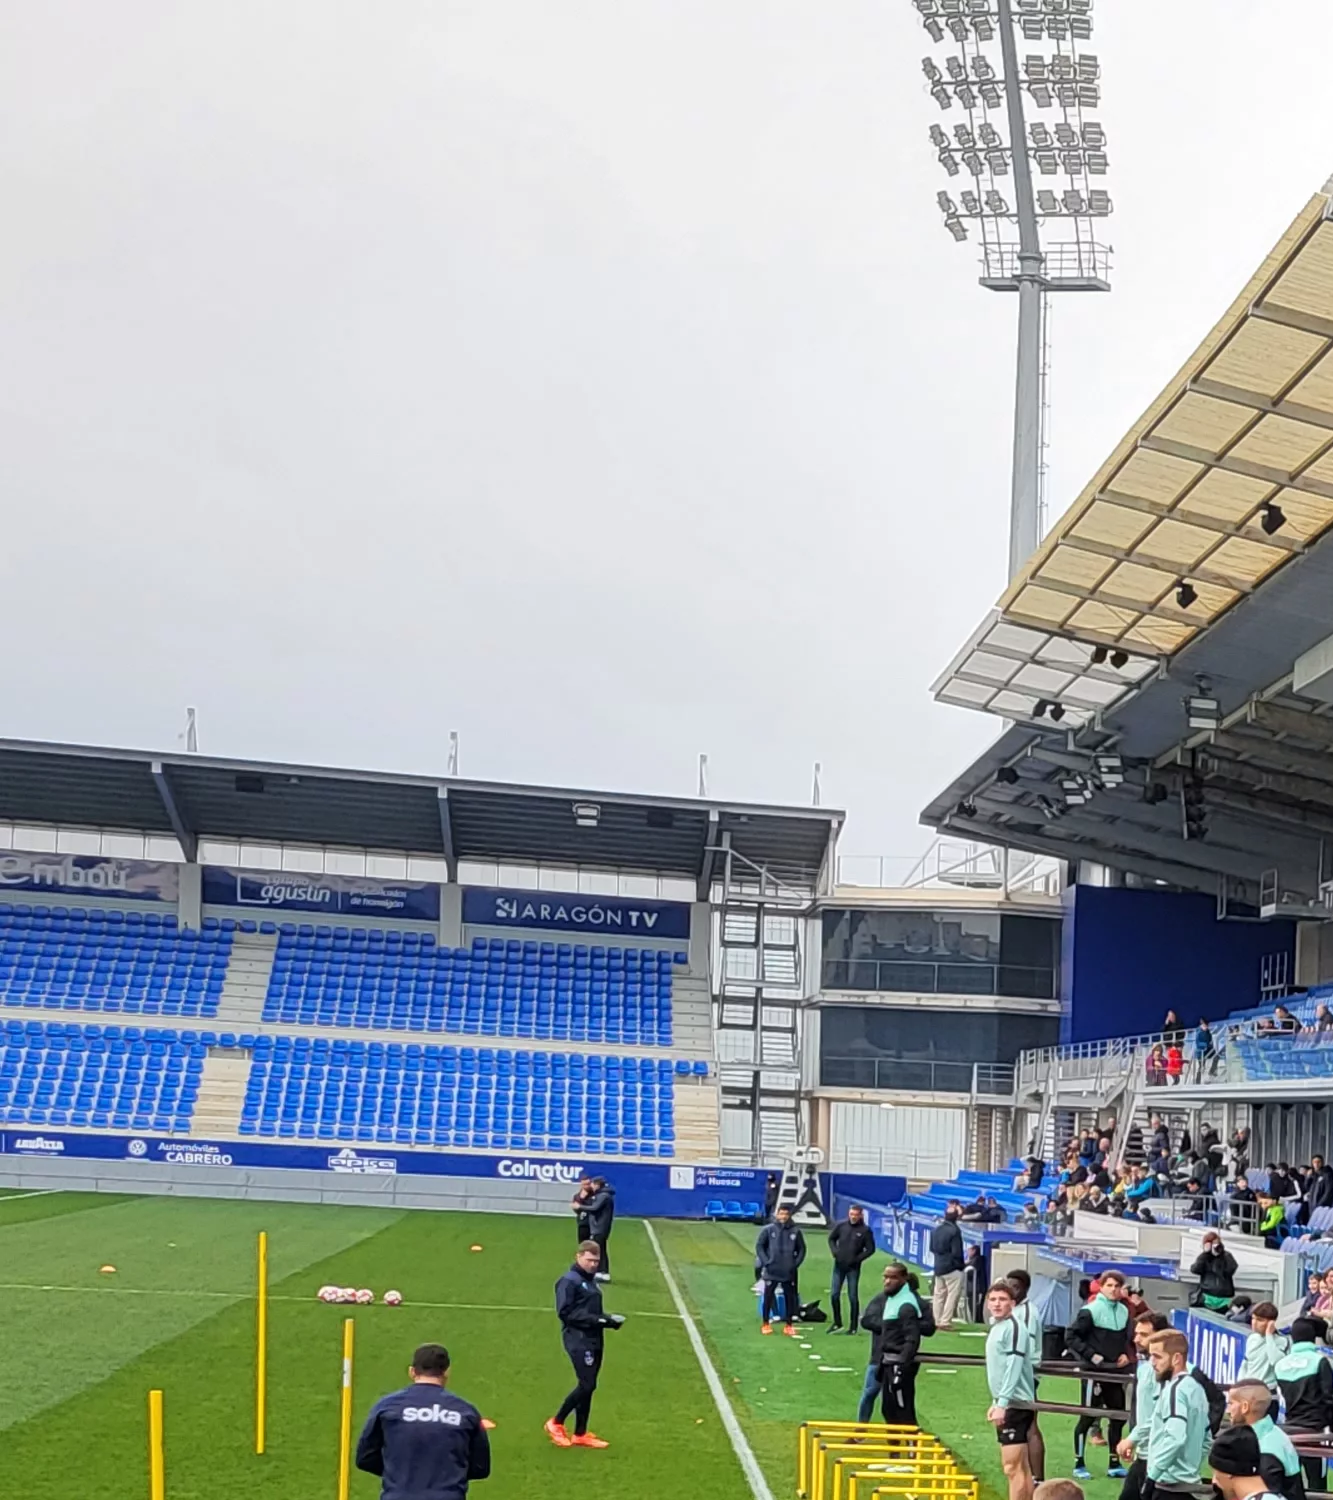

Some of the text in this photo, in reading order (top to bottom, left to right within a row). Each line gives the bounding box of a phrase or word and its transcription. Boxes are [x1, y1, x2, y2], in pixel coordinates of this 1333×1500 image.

[521, 903, 658, 928] ARAGÓN TV
[158, 1142, 219, 1154] Automóviles
[165, 1152, 233, 1165] CABRERO
[498, 1160, 583, 1183] Colnatur
[708, 1177, 741, 1187] Huesca
[403, 1404, 461, 1426] soka
